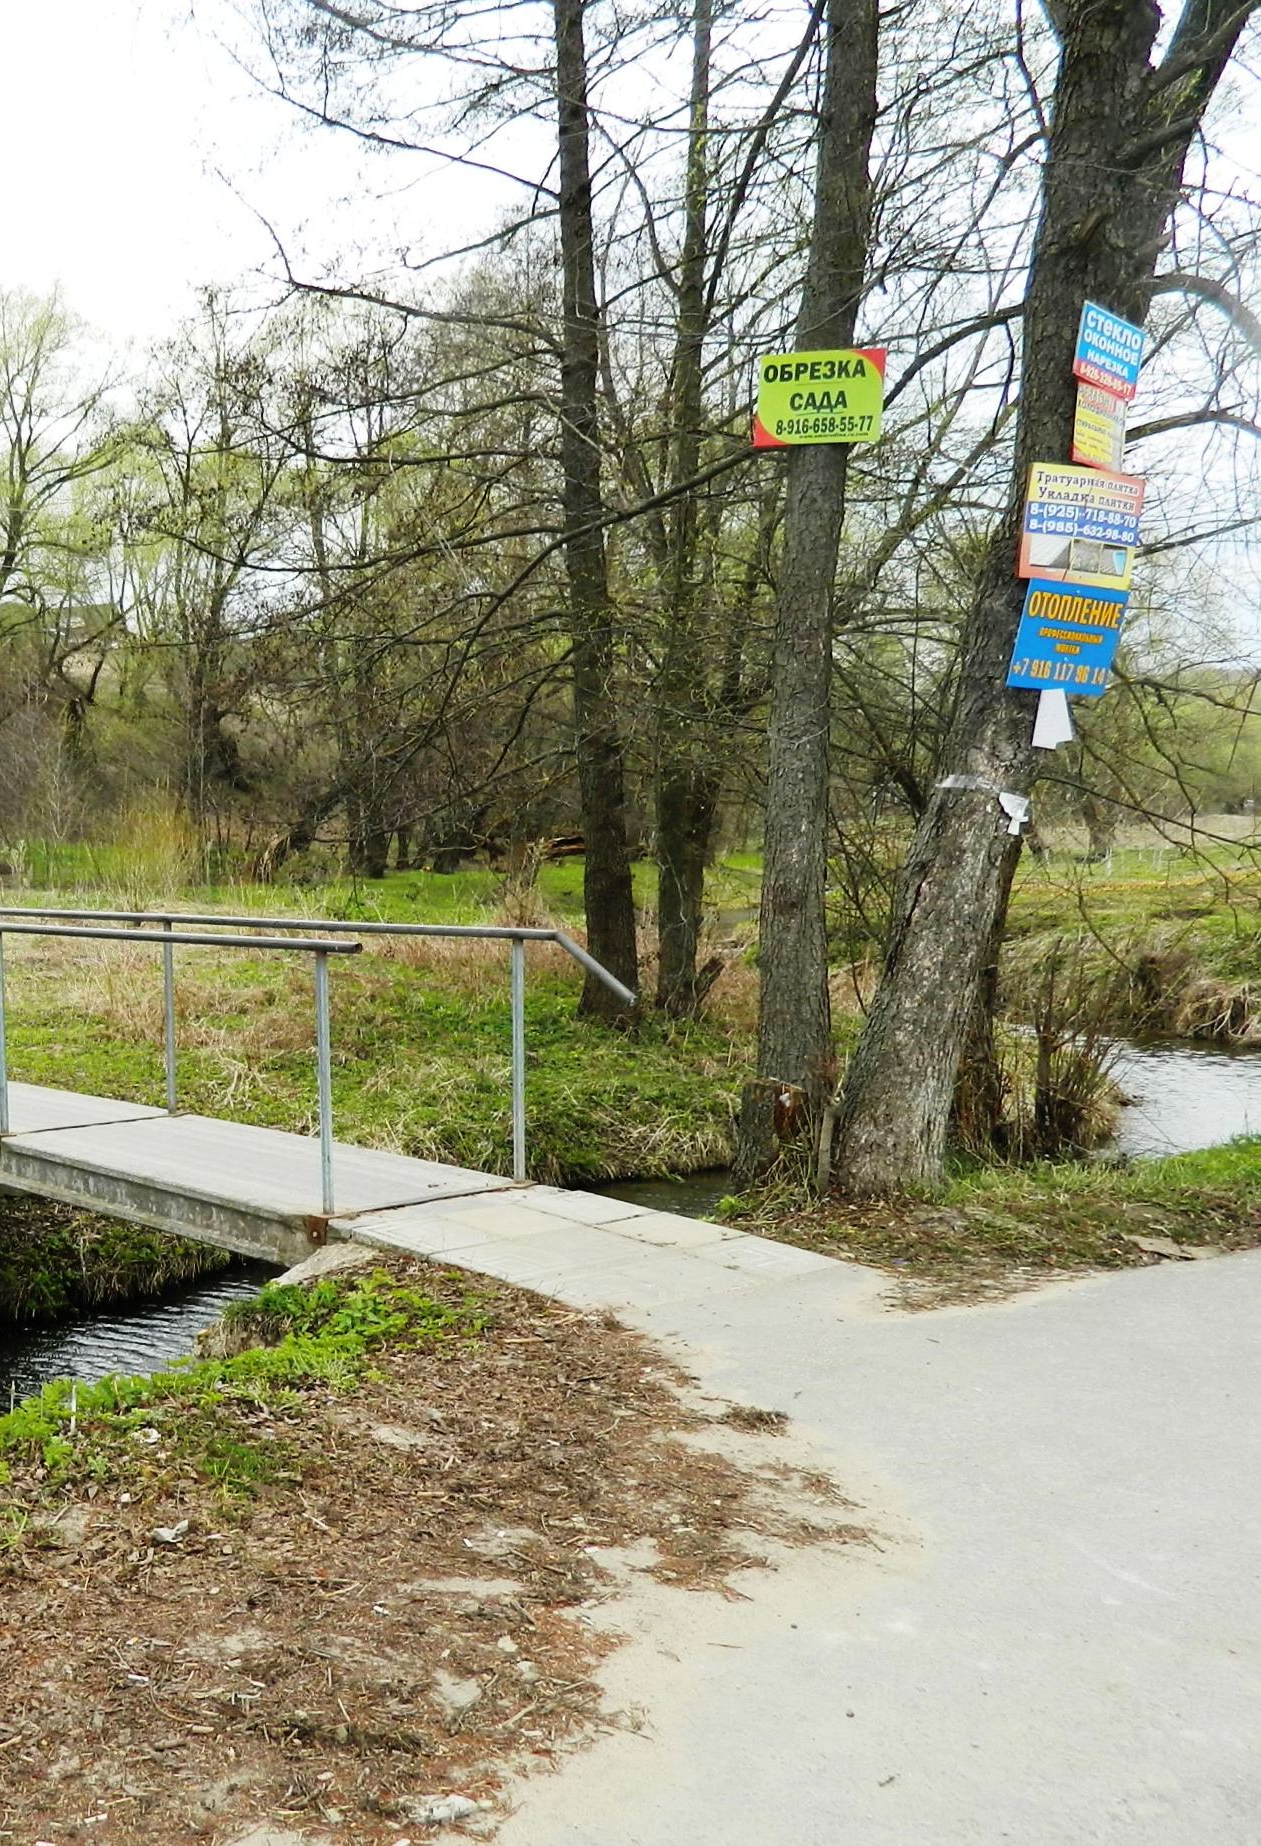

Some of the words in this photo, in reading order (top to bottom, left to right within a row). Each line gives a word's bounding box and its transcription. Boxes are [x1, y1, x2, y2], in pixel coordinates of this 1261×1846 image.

[763, 359, 867, 384] ОБРЕЗКА
[1087, 348, 1129, 379] НАРЕЗКА
[789, 390, 848, 413] САДА
[775, 415, 874, 436] 8-916-658-55-77
[1037, 471, 1105, 489] Тратуарная
[1038, 486, 1095, 504] Укладка
[1028, 590, 1124, 629] ОТОПЛЕНИЕ
[1012, 657, 1030, 676] +7
[1030, 659, 1052, 679] 916
[1053, 662, 1075, 681] 117
